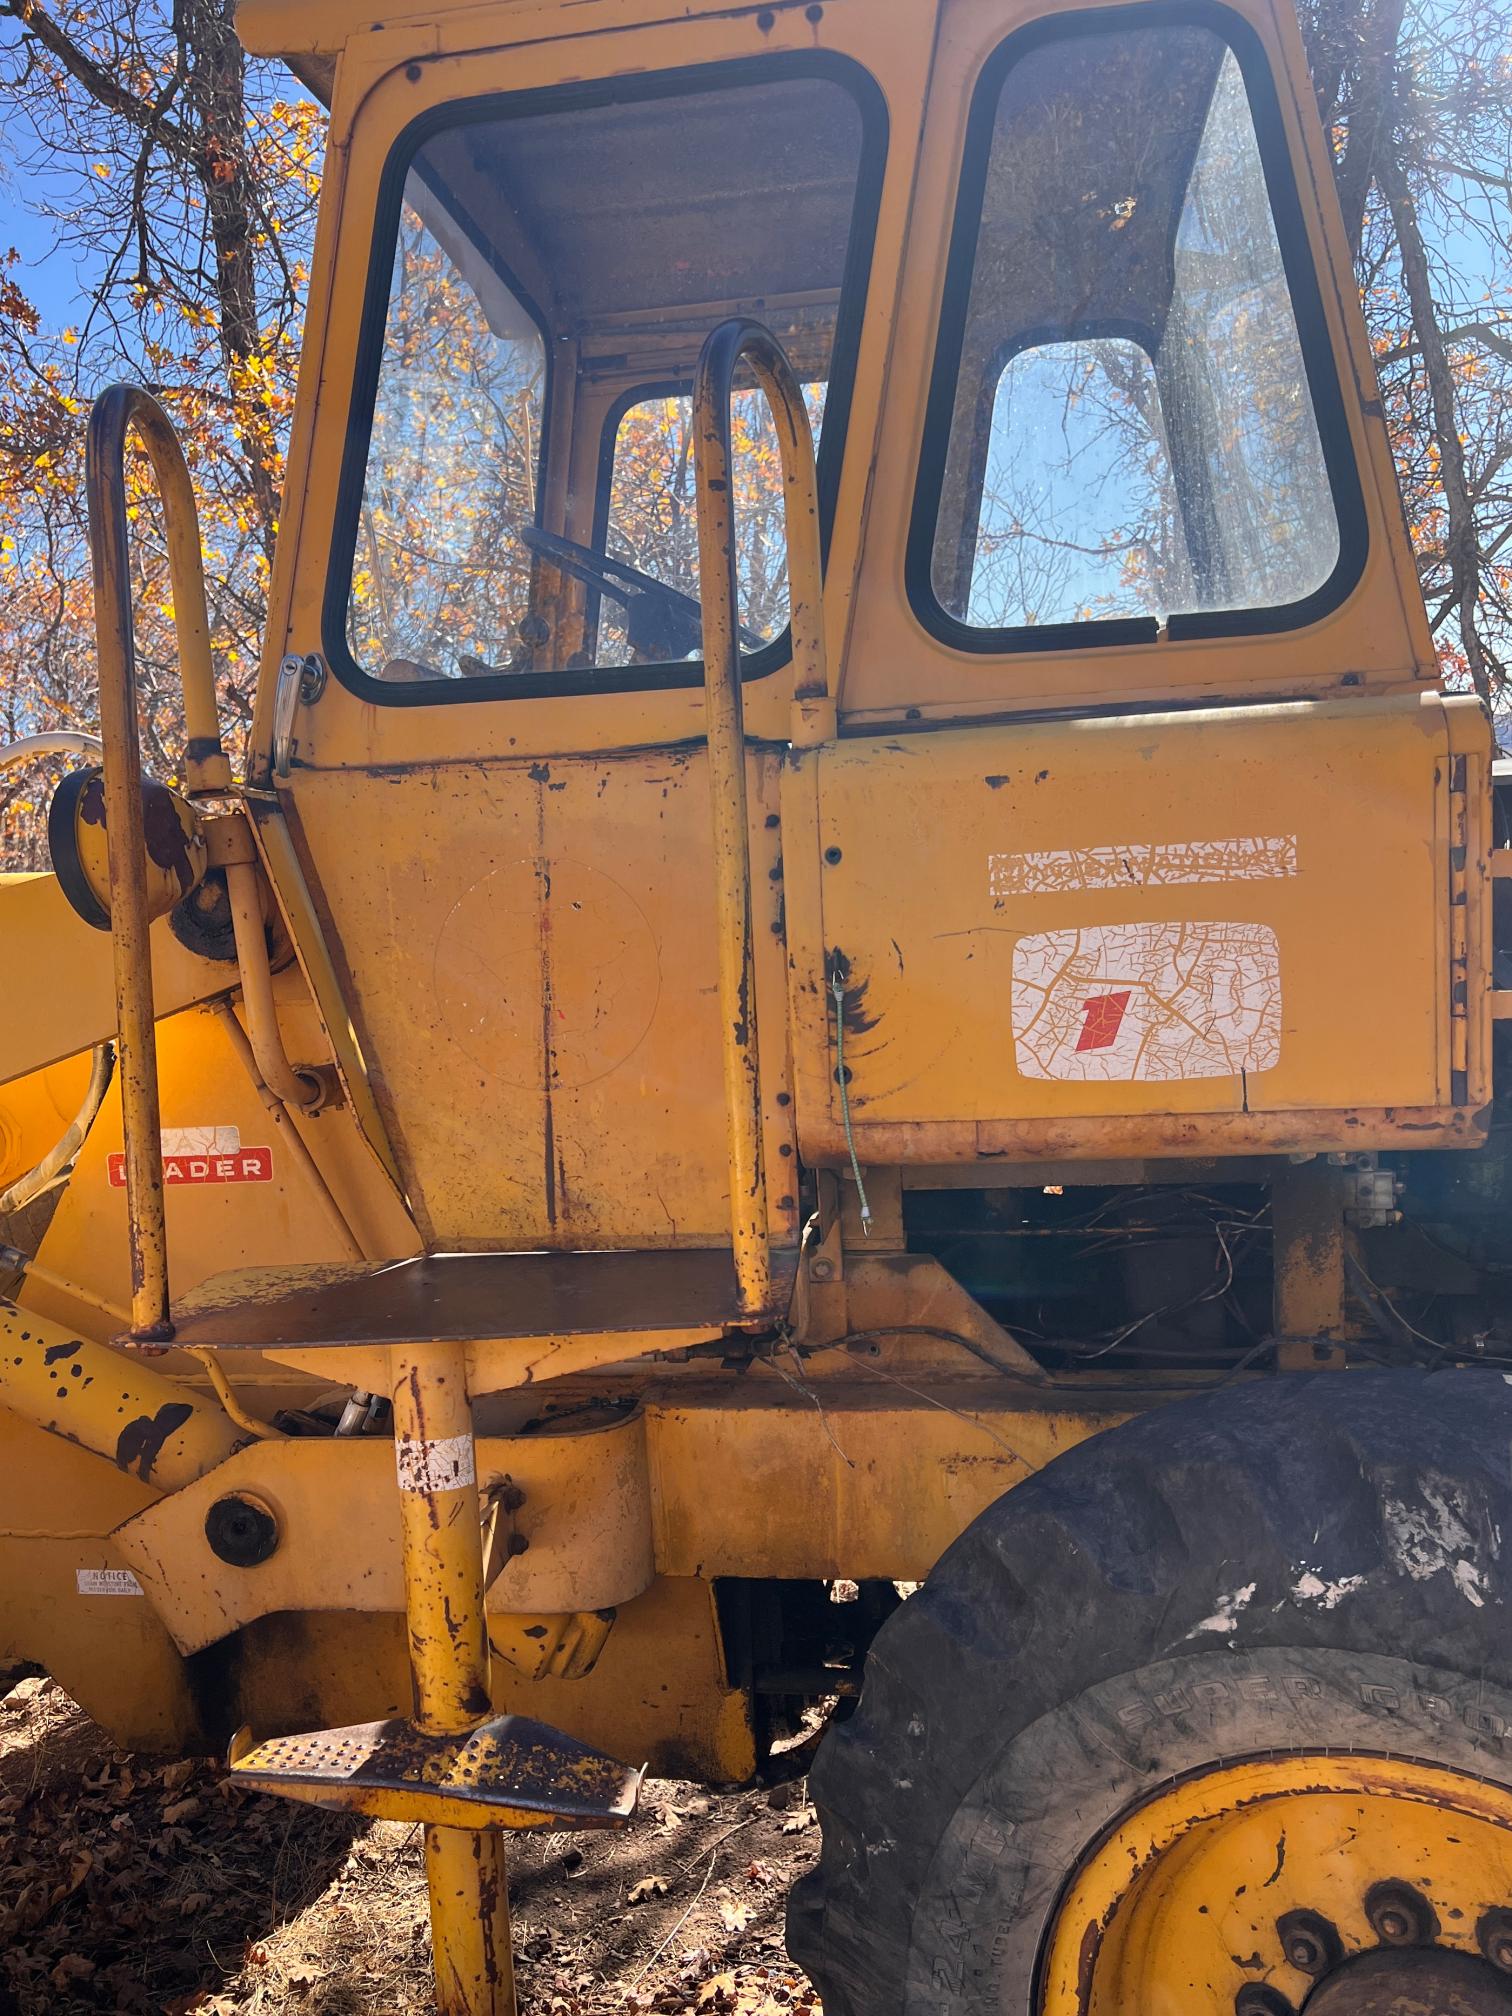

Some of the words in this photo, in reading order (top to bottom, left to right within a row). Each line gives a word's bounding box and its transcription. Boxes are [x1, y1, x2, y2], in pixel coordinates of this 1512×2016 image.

[119, 1159, 262, 1181] LADER
[93, 1571, 128, 1581] NOTICE
[1115, 1674, 1325, 1730] SUPER
